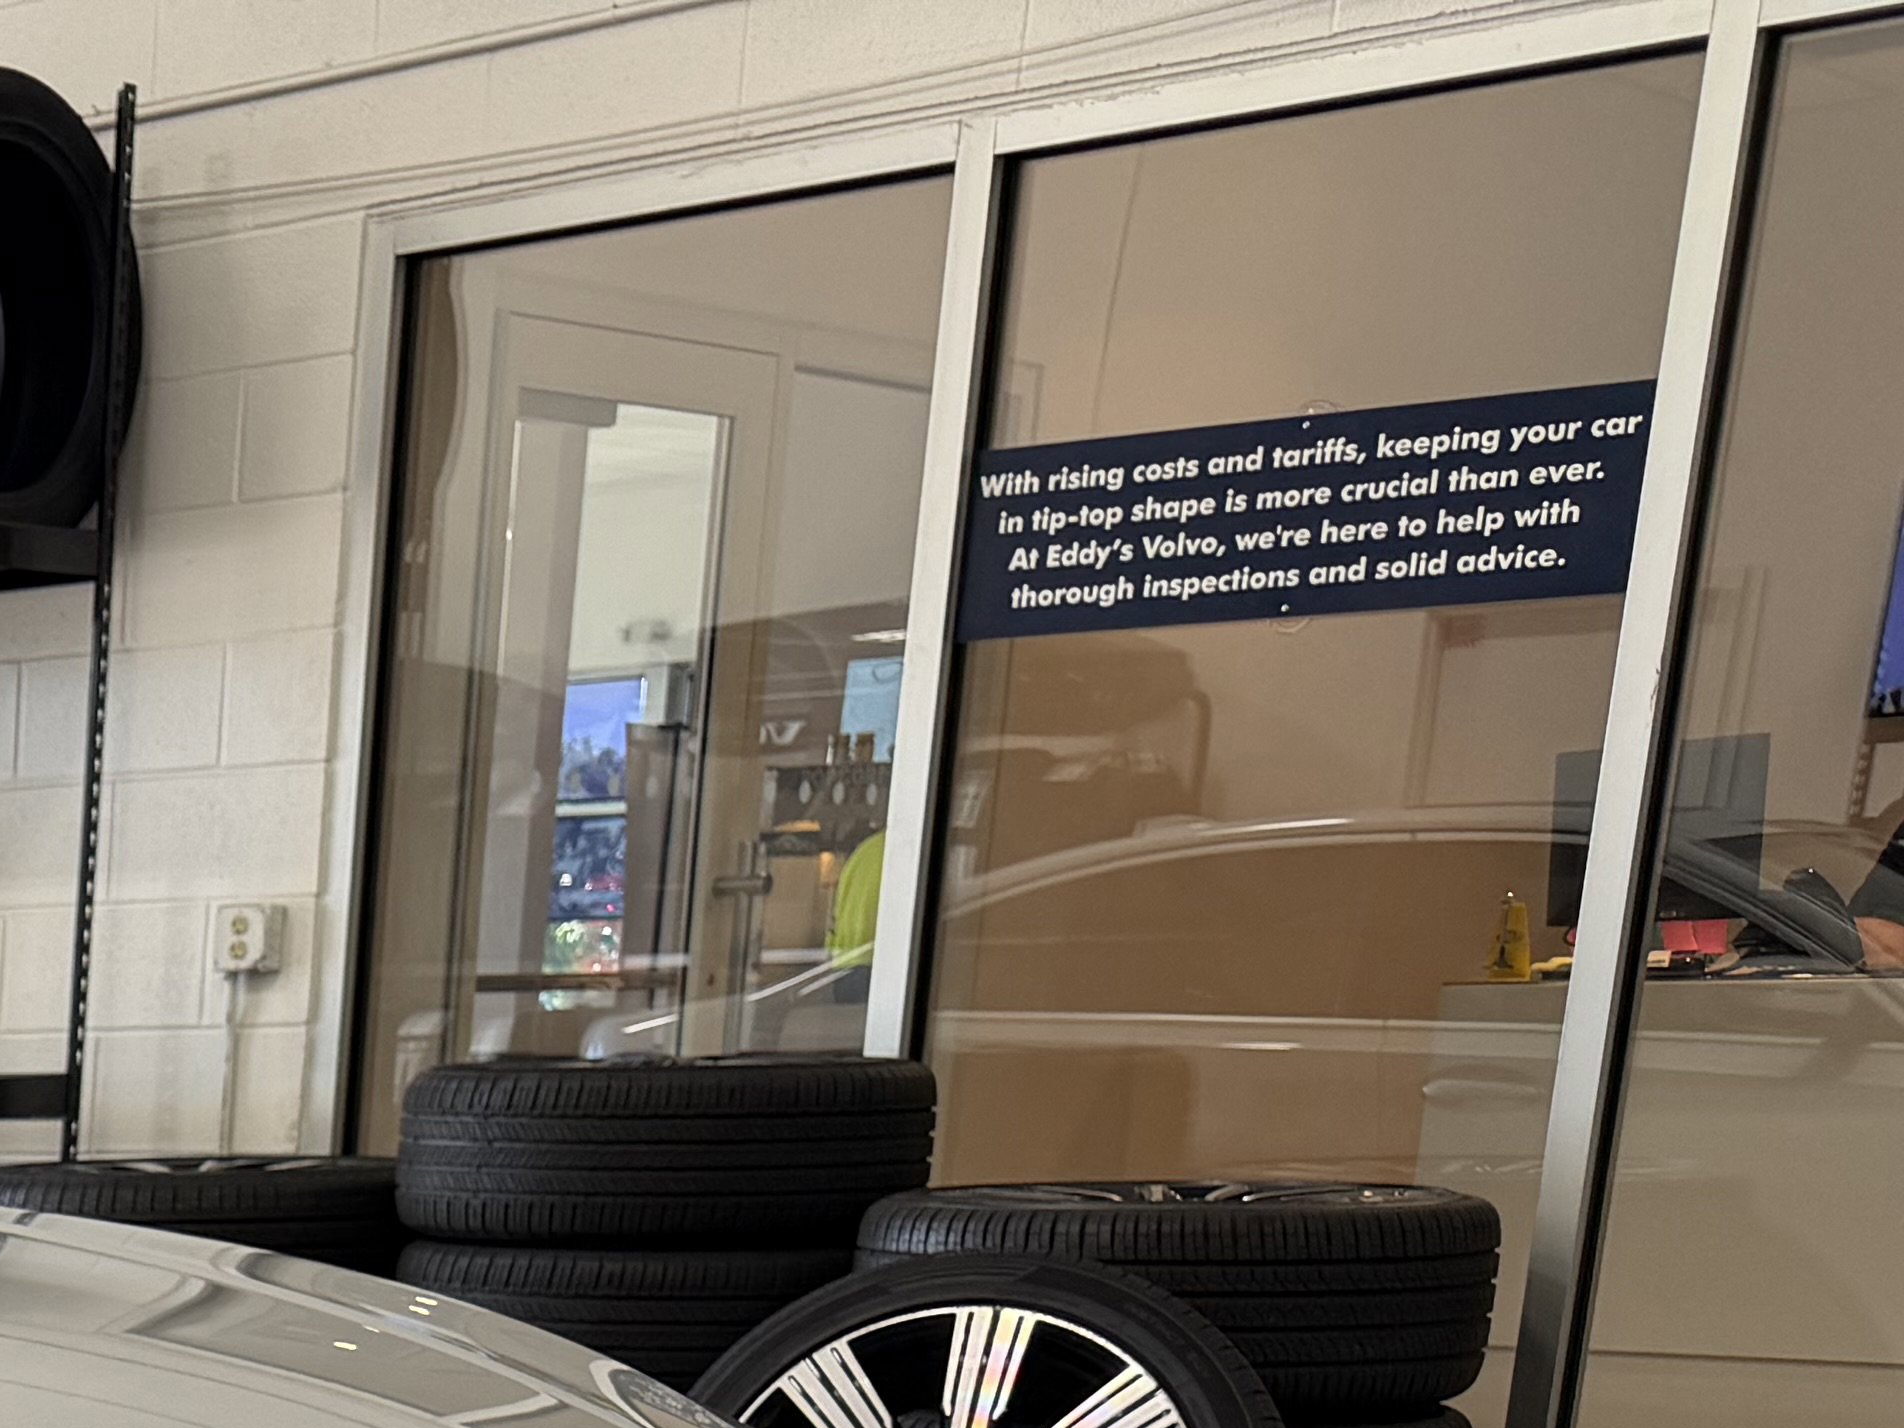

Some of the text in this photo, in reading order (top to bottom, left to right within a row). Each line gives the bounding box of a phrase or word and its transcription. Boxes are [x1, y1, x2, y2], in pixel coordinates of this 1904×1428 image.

[980, 414, 1643, 498] With rising costs and tariffs, keeping your car
[998, 460, 1605, 536] in tip-top shape is more crucial than ever.
[1008, 497, 1581, 572] At Eddy’s Volvo, we're here to help with
[1010, 544, 1566, 609] thorough inspections and solid advice.
